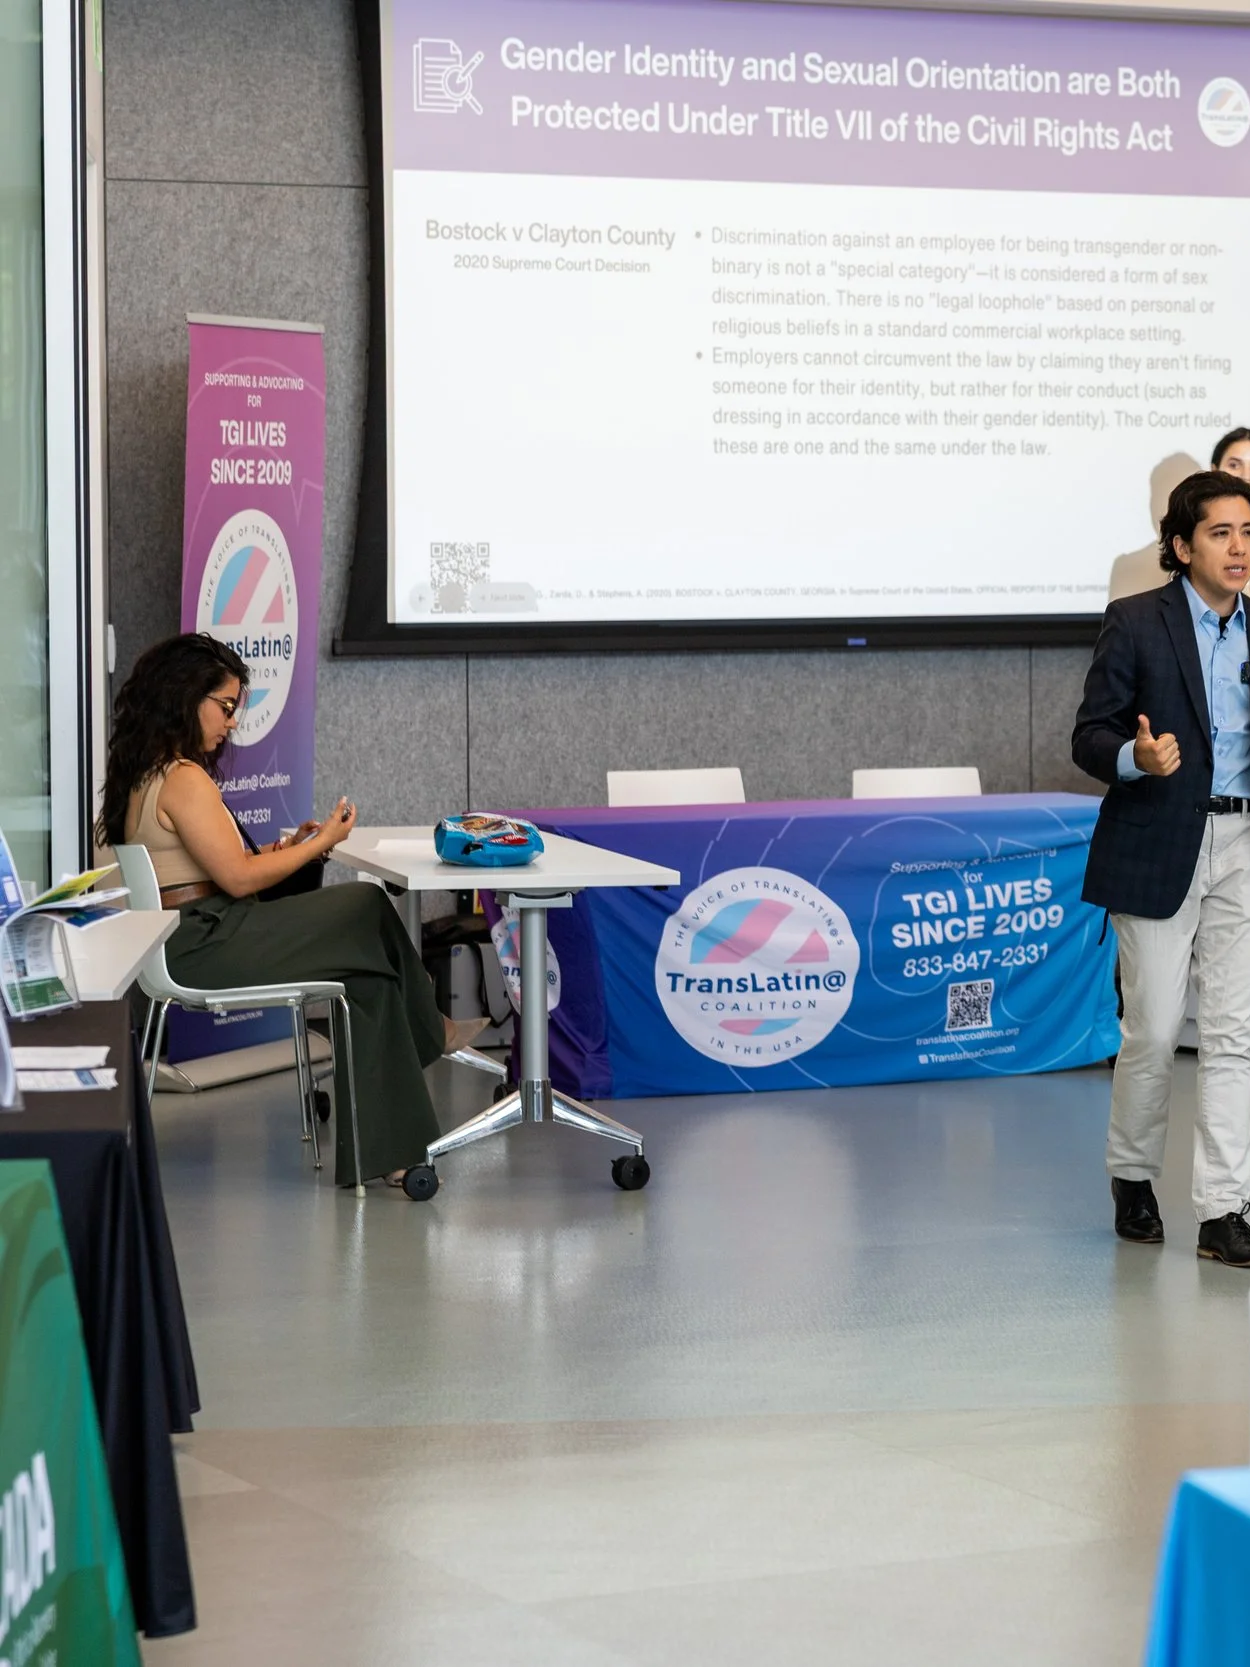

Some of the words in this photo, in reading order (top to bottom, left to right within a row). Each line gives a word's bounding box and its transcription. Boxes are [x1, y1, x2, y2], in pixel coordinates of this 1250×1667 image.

[501, 38, 616, 73] Gender
[625, 44, 734, 86] Identity
[742, 52, 795, 81] and
[804, 53, 897, 86] Sexual
[906, 58, 1060, 92] Orientation
[1068, 73, 1110, 95] are
[1119, 67, 1180, 98] Both
[512, 96, 659, 131] Protected
[669, 103, 758, 135] Under
[765, 107, 828, 138] Title
[836, 110, 871, 140] VII
[881, 113, 908, 141] of
[915, 114, 960, 143] the
[968, 115, 1025, 146] Civil
[1034, 118, 1120, 155] Rights
[1127, 122, 1173, 151] Act
[426, 220, 506, 241] Bostock
[513, 227, 523, 241] v
[529, 223, 601, 247] Clayton
[608, 225, 675, 250] County
[712, 227, 827, 246] Discrimination
[833, 234, 890, 251] against
[896, 236, 914, 248] an
[920, 234, 995, 254] employee
[1001, 235, 1021, 251] for
[1027, 236, 1069, 257] being
[1074, 238, 1166, 258] transgender
[1170, 243, 1185, 255] or
[1190, 244, 1223, 256] non-
[454, 255, 489, 269] 2020
[493, 256, 551, 272] Supreme
[555, 257, 591, 271] Court
[595, 259, 650, 272] Decision
[712, 257, 762, 278] binary
[768, 263, 779, 275] is
[785, 261, 810, 275] not
[817, 264, 825, 276] a
[831, 261, 893, 280] "special
[1005, 268, 1016, 281] is
[1021, 267, 1105, 282] considered
[1110, 271, 1119, 283] a
[1124, 268, 1158, 283] form
[1163, 269, 1177, 284] of
[1183, 272, 1207, 285] sex
[712, 287, 829, 306] discrimination.
[837, 290, 882, 307] There
[888, 295, 899, 307] is
[905, 296, 923, 308] no
[930, 293, 973, 312] "legal
[979, 294, 1051, 313] loophole"
[1057, 296, 1102, 311] based
[1108, 299, 1126, 311] on
[1131, 298, 1195, 315] personal
[1200, 301, 1215, 314] or
[713, 318, 781, 338] religious
[787, 319, 840, 335] beliefs
[845, 320, 858, 335] in
[864, 324, 872, 336] a
[878, 321, 947, 337] standard
[953, 324, 1041, 339] commercial
[1047, 325, 1124, 343] workplace
[1130, 327, 1186, 345] setting.
[713, 347, 798, 368] Employers
[803, 351, 858, 365] cannot
[864, 352, 951, 367] circumvent
[957, 352, 981, 367] the
[987, 352, 1012, 367] law
[1018, 354, 1035, 371] by
[1040, 353, 1103, 373] claiming
[1109, 354, 1141, 373] they
[1147, 355, 1188, 370] aren't
[1194, 354, 1231, 375] firing
[205, 372, 250, 388] SUPPORTING
[252, 378, 257, 387] &
[259, 378, 304, 390] ADVOCATING
[713, 381, 787, 394] someone
[793, 379, 814, 395] for
[820, 379, 855, 395] their
[862, 381, 924, 400] identity,
[931, 381, 955, 396] but
[961, 382, 1006, 397] rather
[1013, 381, 1032, 397] for
[1038, 382, 1072, 397] their
[1077, 383, 1139, 398] conduct
[1145, 383, 1184, 401] (such
[1190, 387, 1206, 399] as
[248, 395, 261, 407] FOR
[713, 408, 781, 429] dressing
[787, 412, 801, 424] in
[807, 410, 900, 425] accordance
[905, 410, 937, 425] with
[944, 410, 978, 425] their
[983, 411, 1037, 430] gender
[1043, 411, 1108, 430] identity).
[1115, 411, 1143, 427] The
[1148, 411, 1189, 427] Court
[1194, 413, 1230, 427] ruled
[220, 420, 243, 445] TGI
[248, 421, 286, 447] LIVES
[713, 438, 757, 454] these
[764, 441, 788, 454] are
[794, 442, 823, 455] one
[830, 439, 858, 455] and
[865, 439, 889, 455] the
[895, 443, 936, 455] same
[942, 440, 986, 455] under
[992, 440, 1016, 455] the
[1021, 440, 1050, 455] law.
[211, 458, 254, 484] SINCE
[258, 460, 292, 485] 2009
[260, 773, 290, 788] Coalition
[963, 871, 983, 883] for
[903, 890, 958, 917] TGI
[966, 877, 1053, 911] LIVES
[674, 923, 689, 948] THE
[692, 891, 723, 920] VOICE
[731, 881, 746, 892] OF
[754, 880, 844, 946] TRANSLATIN@S
[892, 916, 986, 949] SINCE
[993, 905, 1064, 936] 2009
[903, 942, 1049, 977] 833-847-2331
[666, 970, 846, 992] TransLatin@
[701, 999, 816, 1012] COALITION
[710, 1036, 724, 1049] IN
[734, 1045, 762, 1054] THE
[773, 1036, 802, 1054] USA
